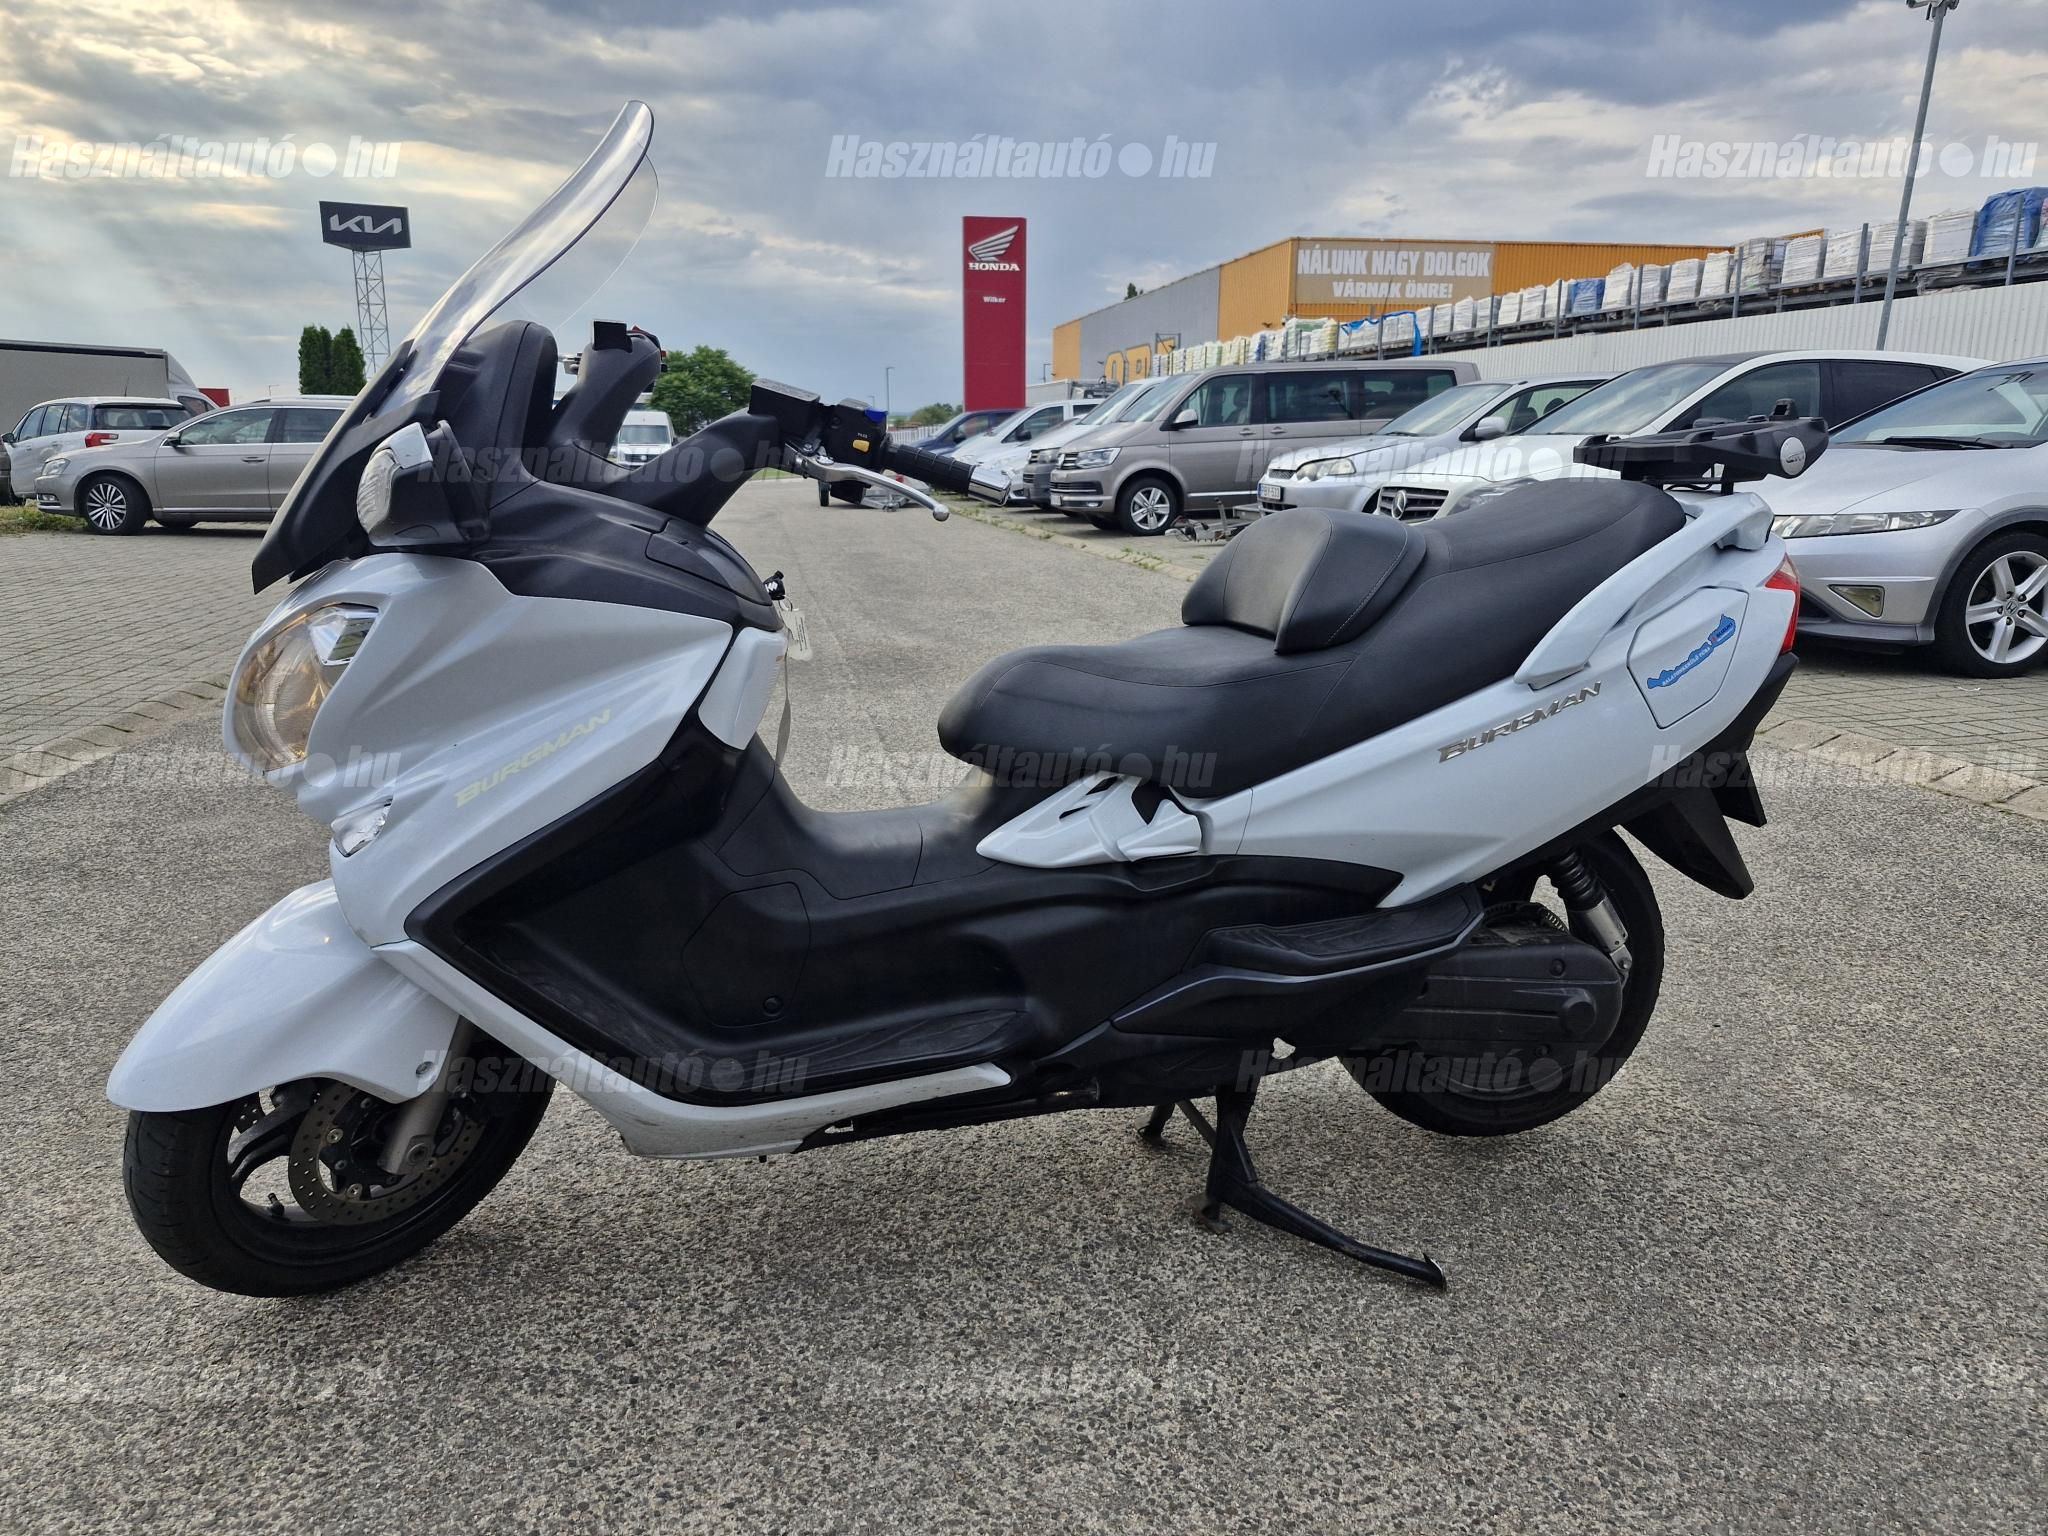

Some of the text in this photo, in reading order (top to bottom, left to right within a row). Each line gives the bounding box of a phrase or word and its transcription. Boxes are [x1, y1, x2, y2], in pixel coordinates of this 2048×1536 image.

[968, 262, 1020, 271] HONDA
[1297, 244, 1491, 277] NÁLUNK NAGY DOLGOK
[1333, 279, 1453, 298] VÁRNAK ÖNRE!
[1437, 680, 1601, 763] BURGMAN
[454, 707, 611, 808] BURGMAN
